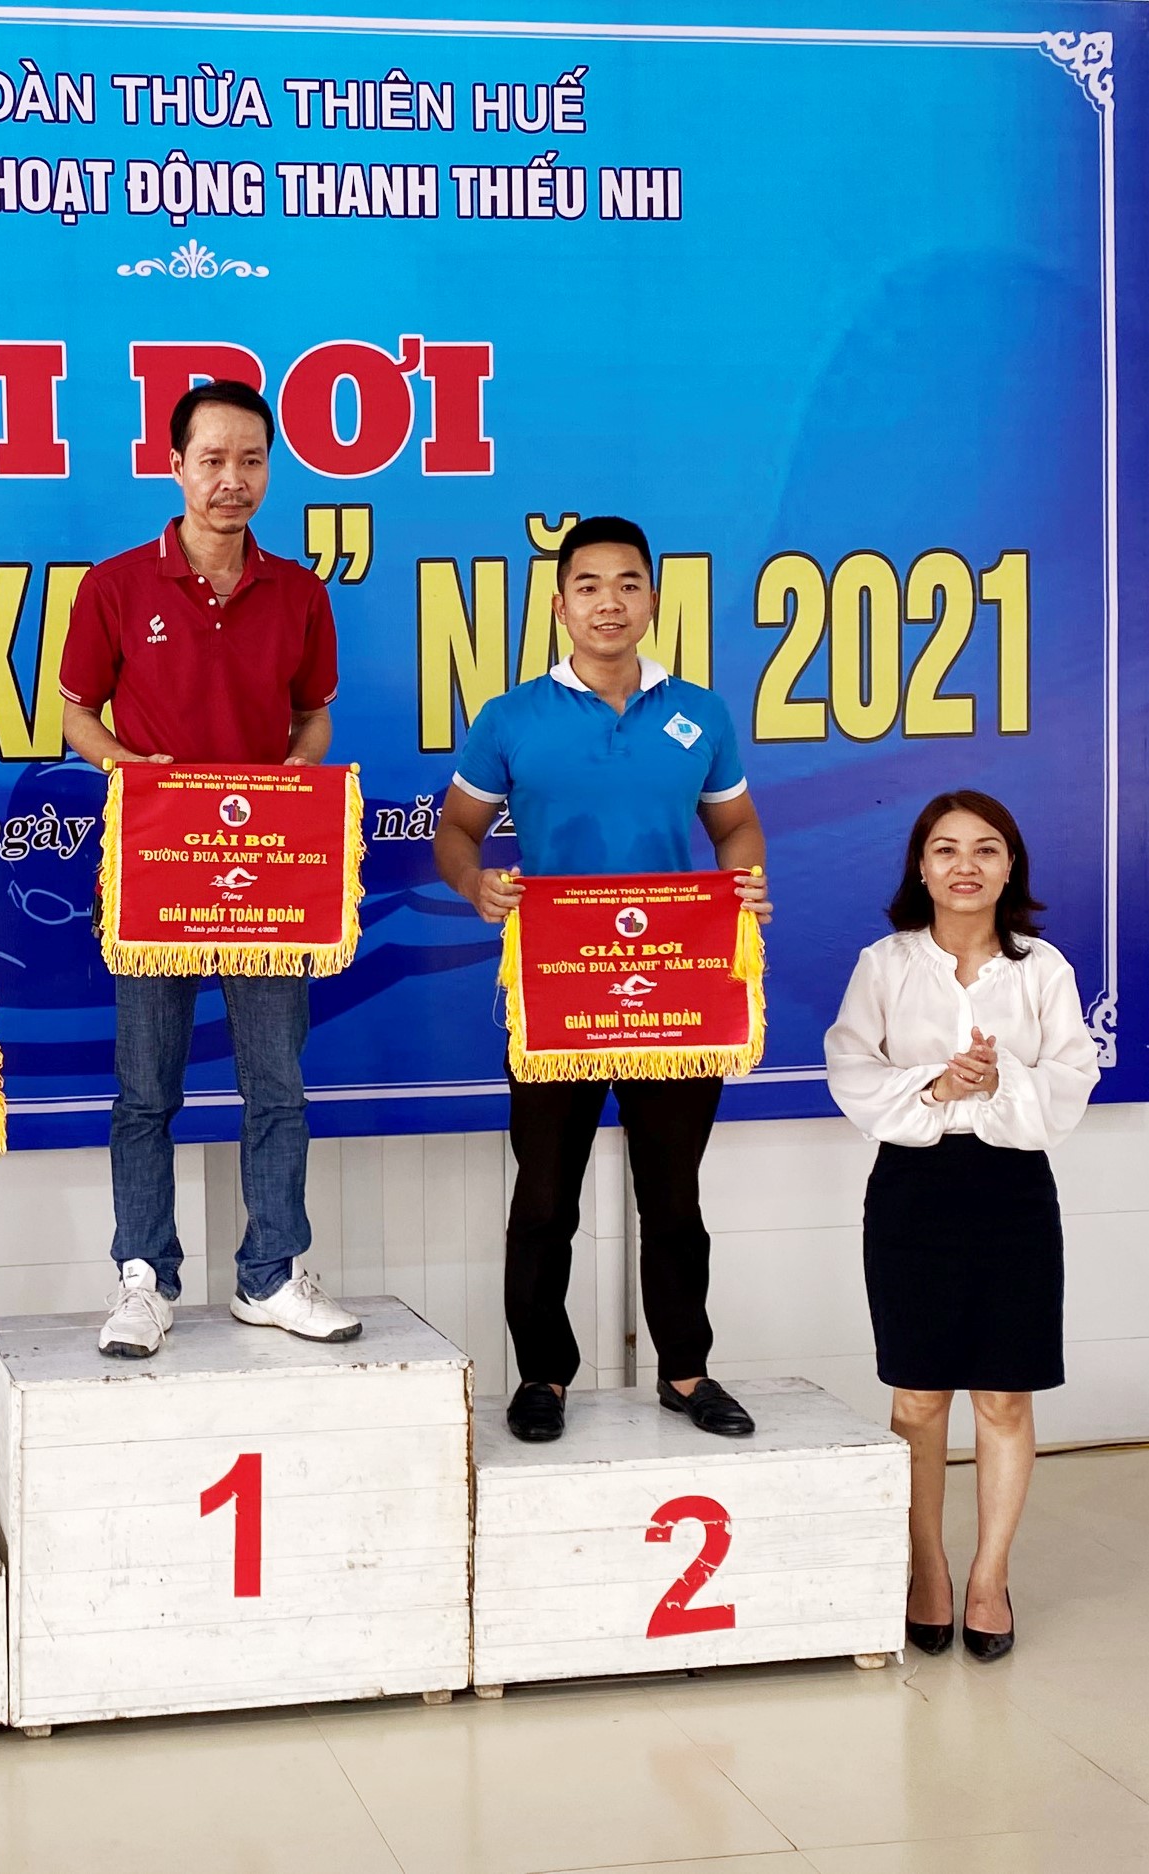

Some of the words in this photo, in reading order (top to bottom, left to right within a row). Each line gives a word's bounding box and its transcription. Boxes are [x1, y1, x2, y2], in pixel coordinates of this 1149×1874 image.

[111, 64, 272, 129] THỪA
[284, 68, 454, 131] THIÊN
[472, 65, 589, 134] HUẾ
[126, 149, 265, 226] ĐỘNG
[276, 162, 439, 219] THANH
[450, 149, 585, 221] THIẾU
[599, 167, 682, 221] NHI
[753, 547, 1030, 743] 2021
[170, 772, 192, 780] TỈNH
[193, 773, 221, 781] ĐOÀN
[281, 775, 300, 783] HUẾ
[185, 781, 202, 789] TÂM
[204, 782, 224, 791] HOẠT
[226, 782, 248, 791] ĐỘNG
[276, 783, 296, 792] THIẾU
[372, 794, 444, 840] nă
[183, 829, 239, 846] GIẢI
[244, 833, 286, 847] BƠI
[139, 848, 189, 862] "ĐƯỜNG
[192, 851, 219, 863] ĐUA
[222, 852, 262, 864] XANH"
[266, 850, 294, 864] NĂM
[298, 853, 328, 864] 2021
[565, 888, 587, 896] TỈNH
[619, 887, 646, 895] THỪA
[648, 886, 677, 894] THIÊN
[679, 885, 699, 893] HUẾ
[599, 897, 619, 905] HOẠT
[621, 897, 644, 905] ĐỘNG
[673, 894, 695, 902] THIẾU
[159, 903, 187, 922] GIẢI
[190, 903, 226, 922] NHẤT
[229, 905, 264, 922] TOÀN
[267, 905, 305, 923] ĐOÀN
[579, 941, 635, 957] GIẢI
[641, 941, 683, 956] BƠI
[538, 960, 585, 974] "ĐƯỜNG
[589, 961, 617, 973] ĐUA
[619, 960, 660, 972] XANH"
[664, 957, 693, 970] NĂM
[698, 958, 728, 969] 2021
[565, 1010, 591, 1029] GIẢI
[595, 1010, 619, 1028] NHÌ
[622, 1010, 659, 1028] TOÀN
[663, 1009, 702, 1026] ĐOÀN
[200, 1454, 261, 1597] 1
[646, 1496, 735, 1638] 2
